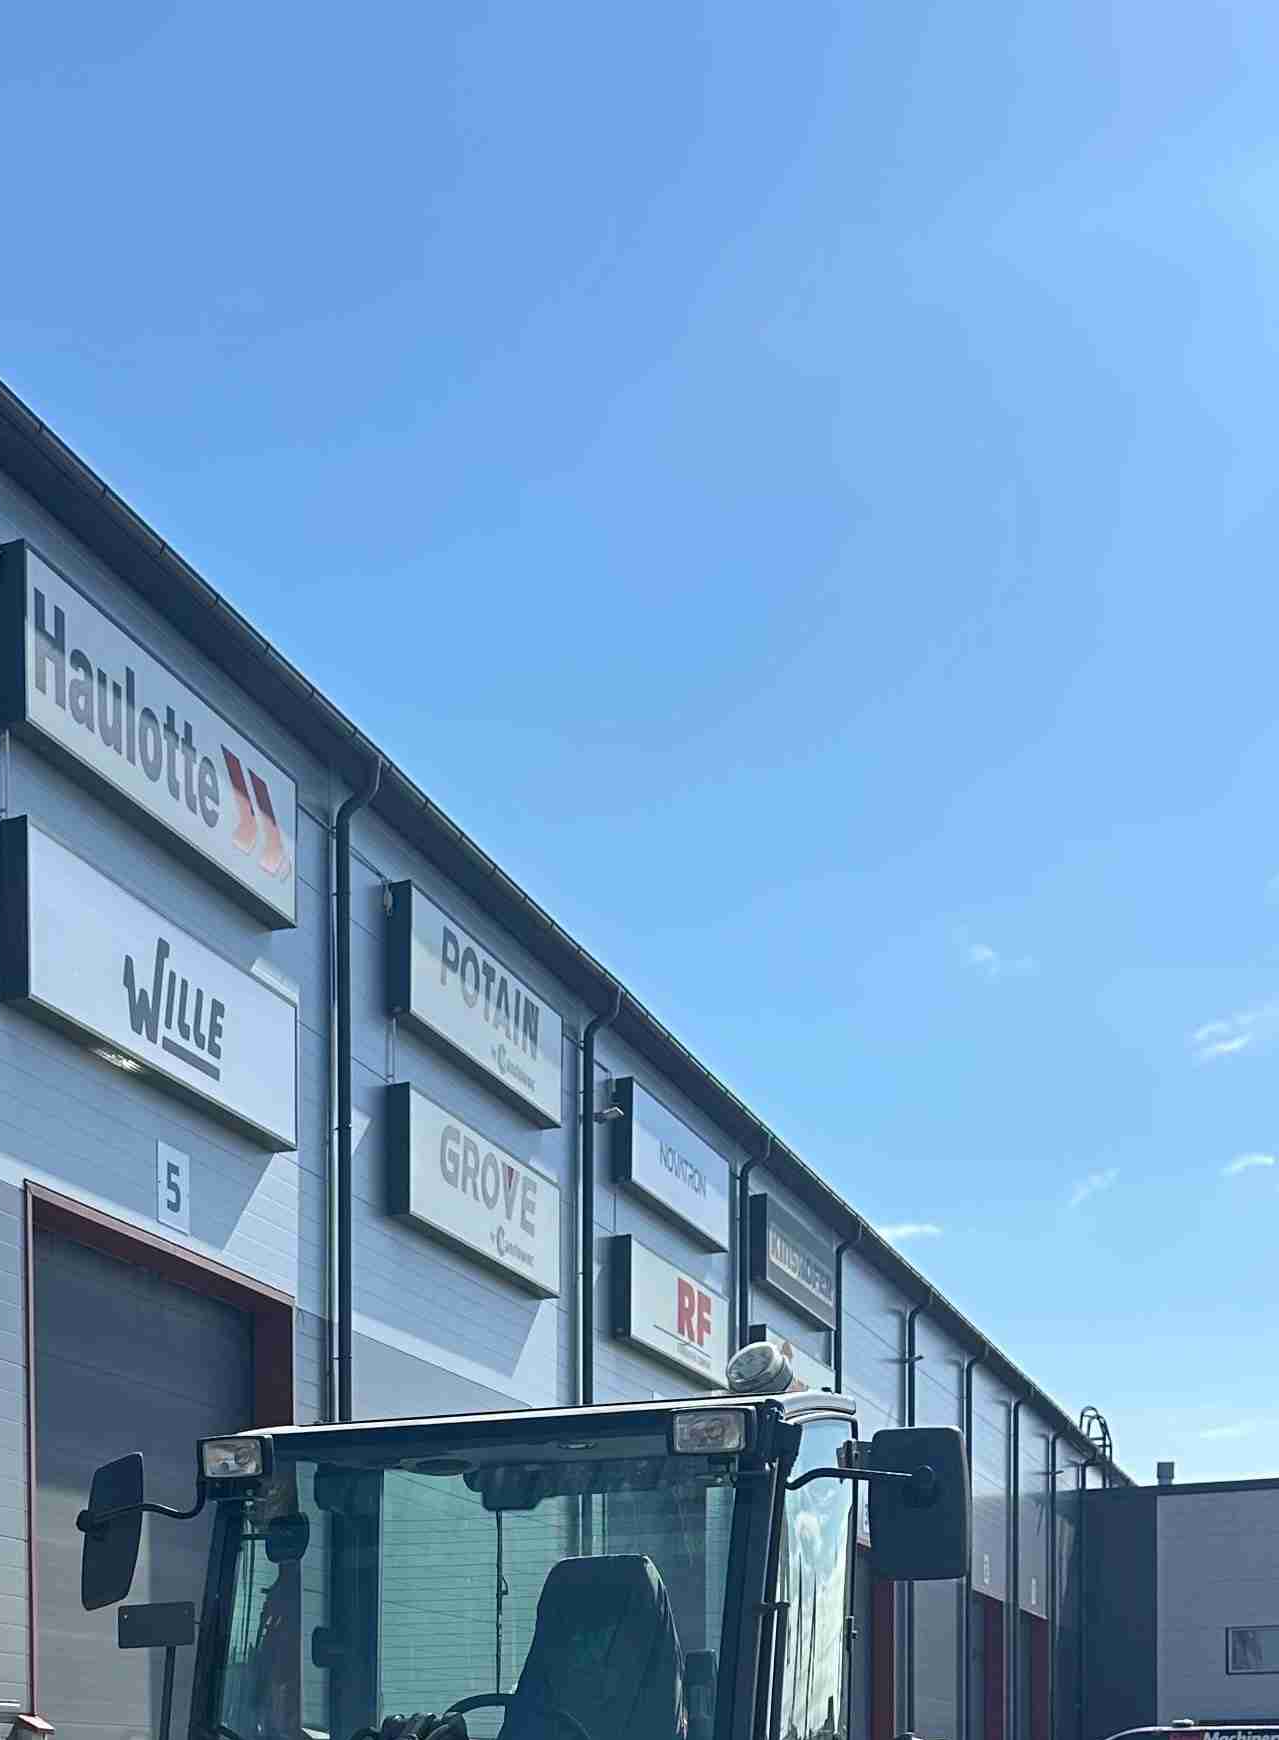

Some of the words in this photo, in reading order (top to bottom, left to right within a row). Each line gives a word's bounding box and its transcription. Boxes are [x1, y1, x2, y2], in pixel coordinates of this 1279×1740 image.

[33, 586, 221, 829] Haulotte
[440, 925, 540, 1062] POTAIN
[166, 1160, 182, 1214] 5
[440, 1125, 537, 1238] GROVE
[677, 1278, 712, 1346] RF
